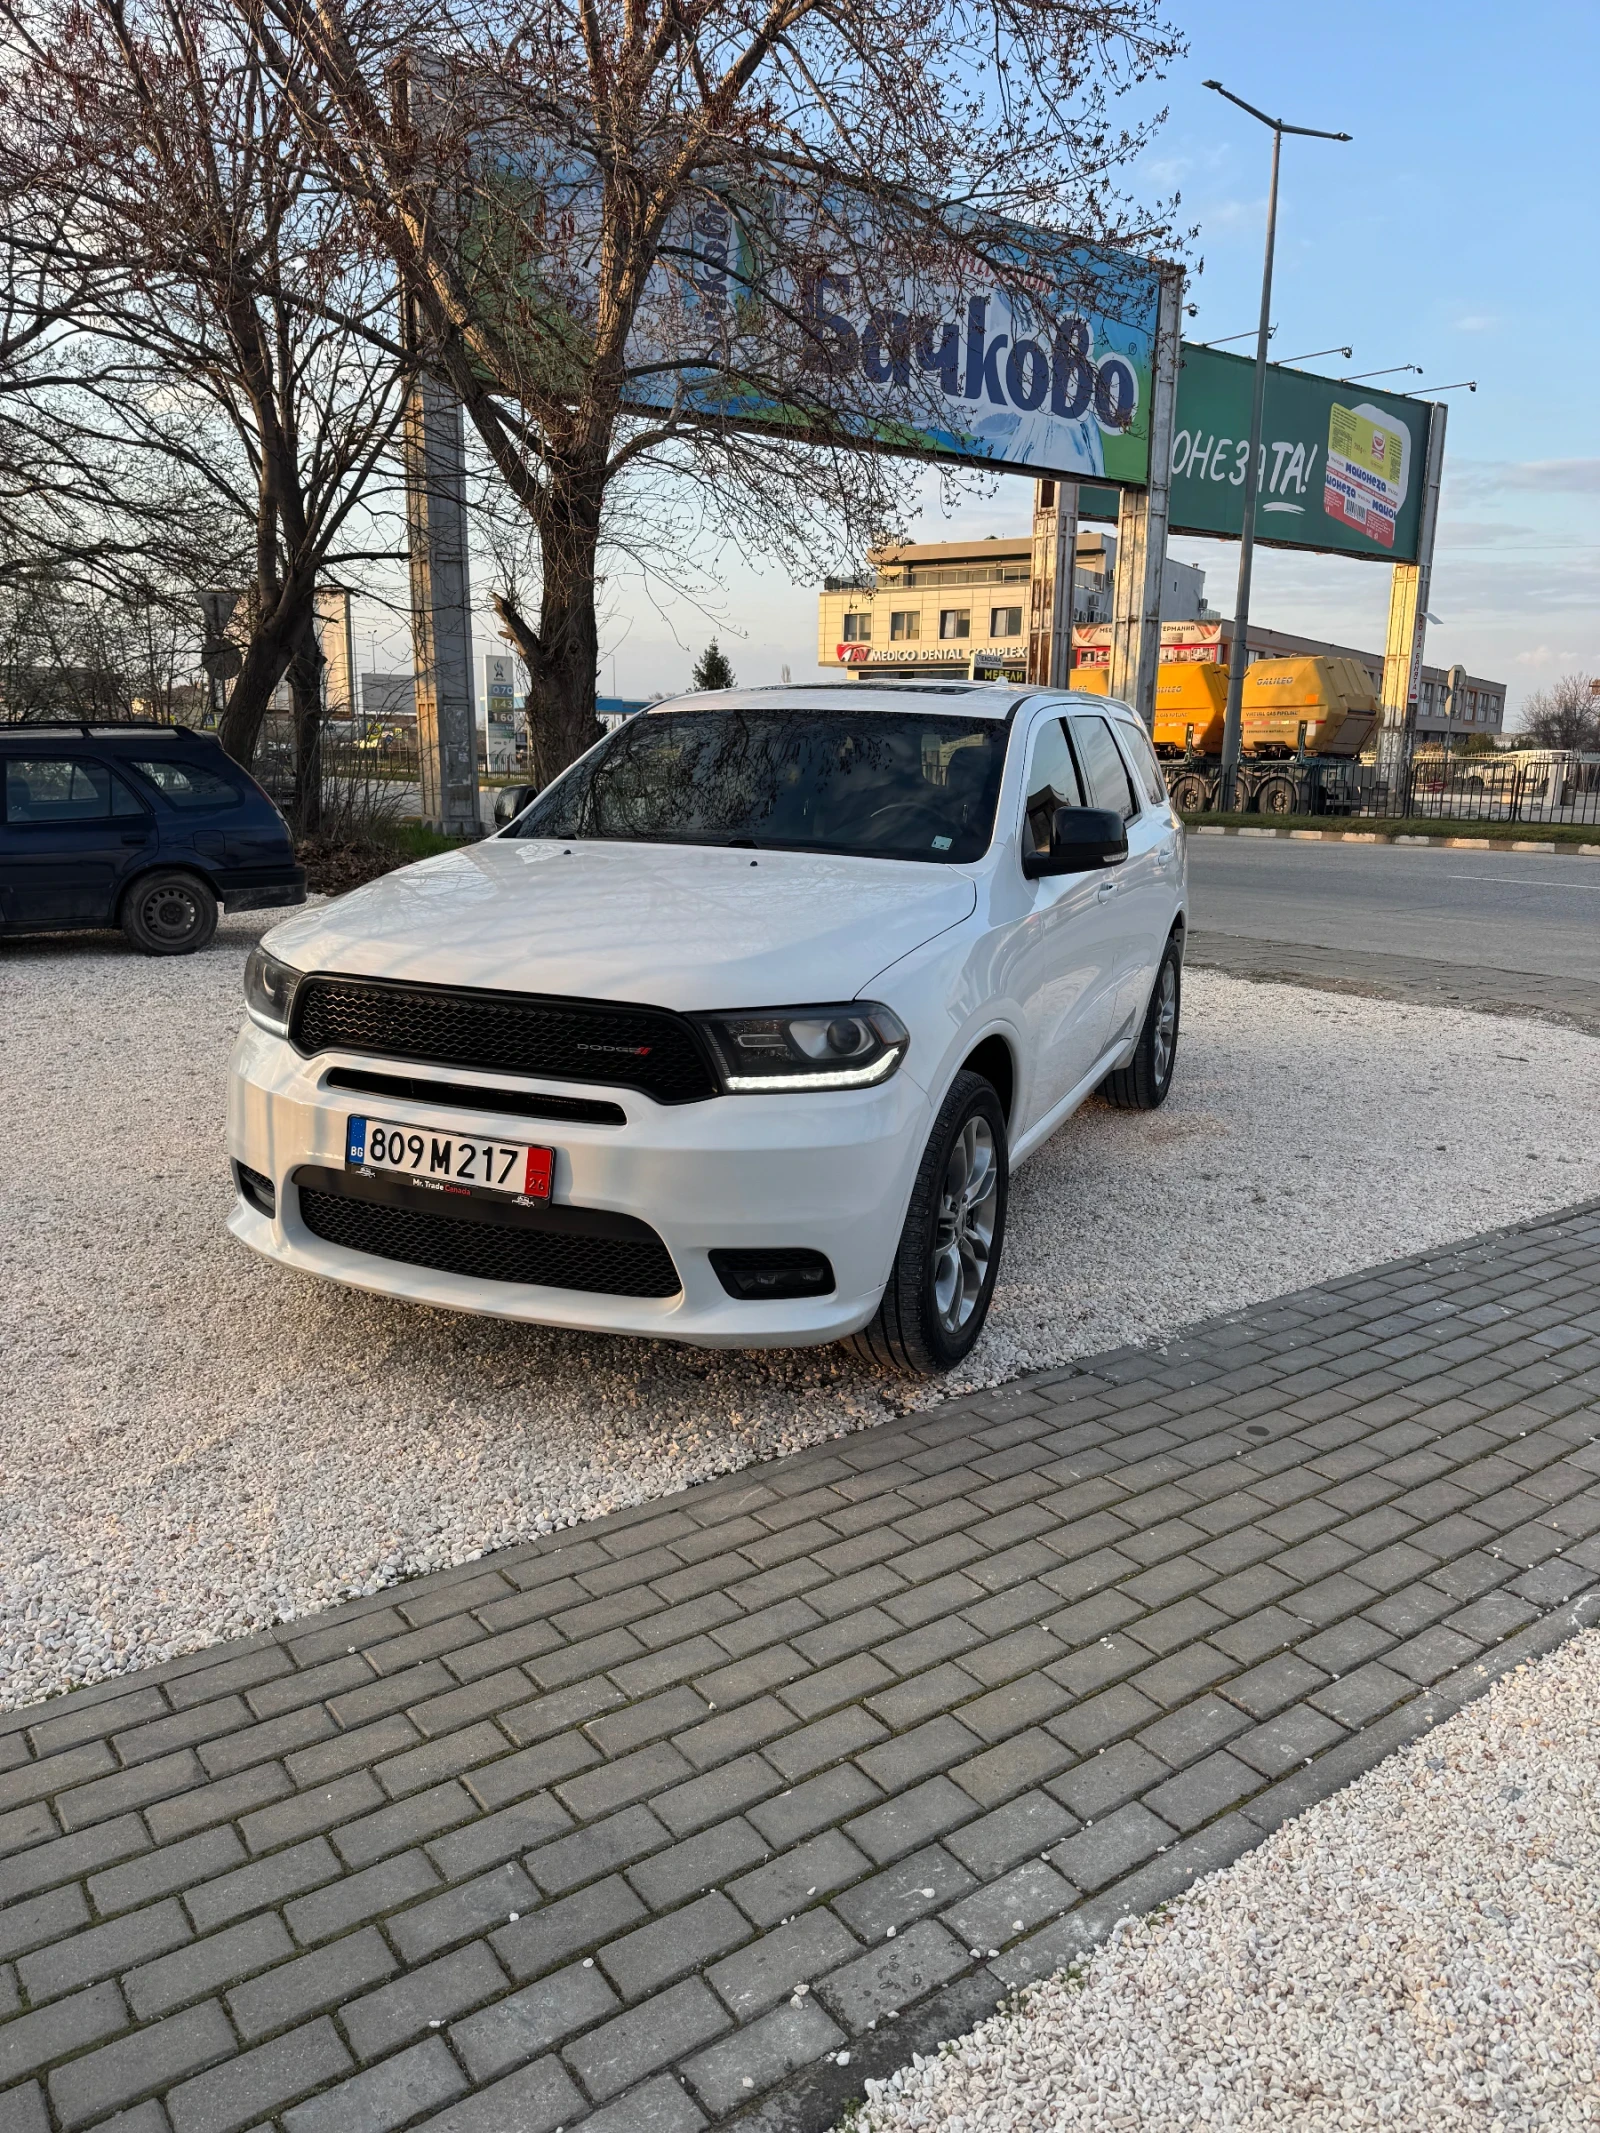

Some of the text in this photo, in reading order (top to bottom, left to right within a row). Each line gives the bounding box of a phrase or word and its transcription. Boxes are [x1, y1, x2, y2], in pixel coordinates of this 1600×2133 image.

[806, 272, 1135, 429] Бачково
[872, 649, 916, 662] MEDICO
[920, 649, 963, 660] DENTAL
[969, 646, 1028, 659] COMPLEX
[1256, 676, 1294, 686] GALILEO
[577, 1043, 639, 1053] DODGE
[350, 1146, 364, 1158] BG
[412, 1178, 424, 1188] Mr.
[529, 1177, 545, 1192] 26
